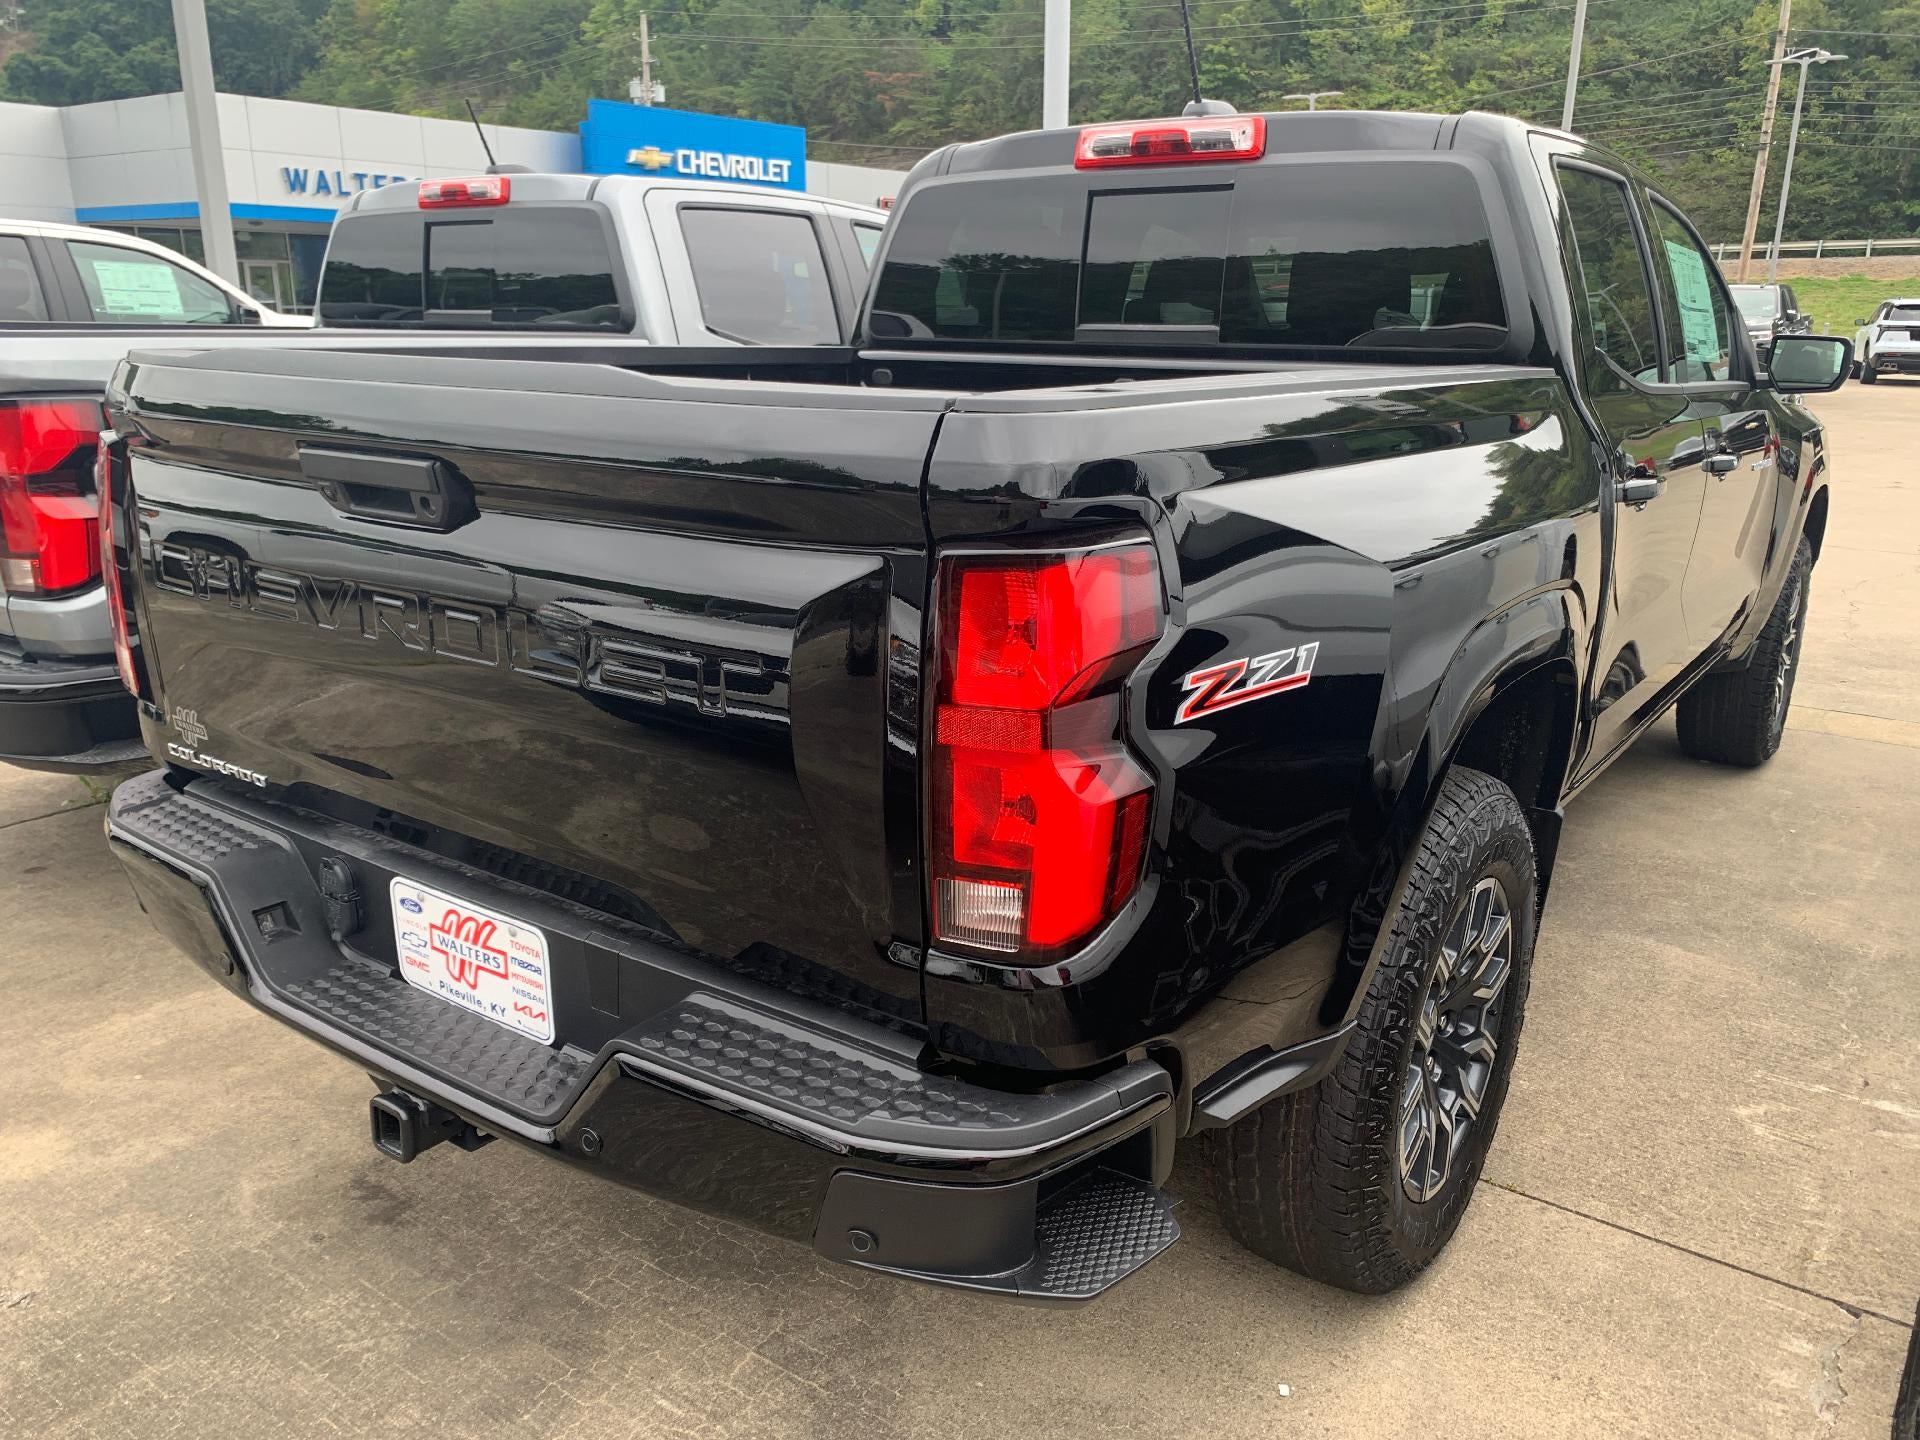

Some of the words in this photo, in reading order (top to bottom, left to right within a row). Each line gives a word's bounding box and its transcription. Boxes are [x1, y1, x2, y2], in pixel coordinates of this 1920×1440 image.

[281, 166, 412, 196] WALTE
[676, 149, 792, 183] CHEVROLET
[151, 539, 762, 718] CHEVROLET
[1174, 641, 1320, 726] Z71
[167, 742, 268, 788] COLORADO
[405, 955, 431, 973] GMC
[437, 934, 501, 969] WALTERS
[510, 939, 541, 961] TOYOTA
[439, 979, 487, 1012] Pikeville,
[490, 1001, 506, 1018] KY
[512, 986, 545, 1005] NISSAN
